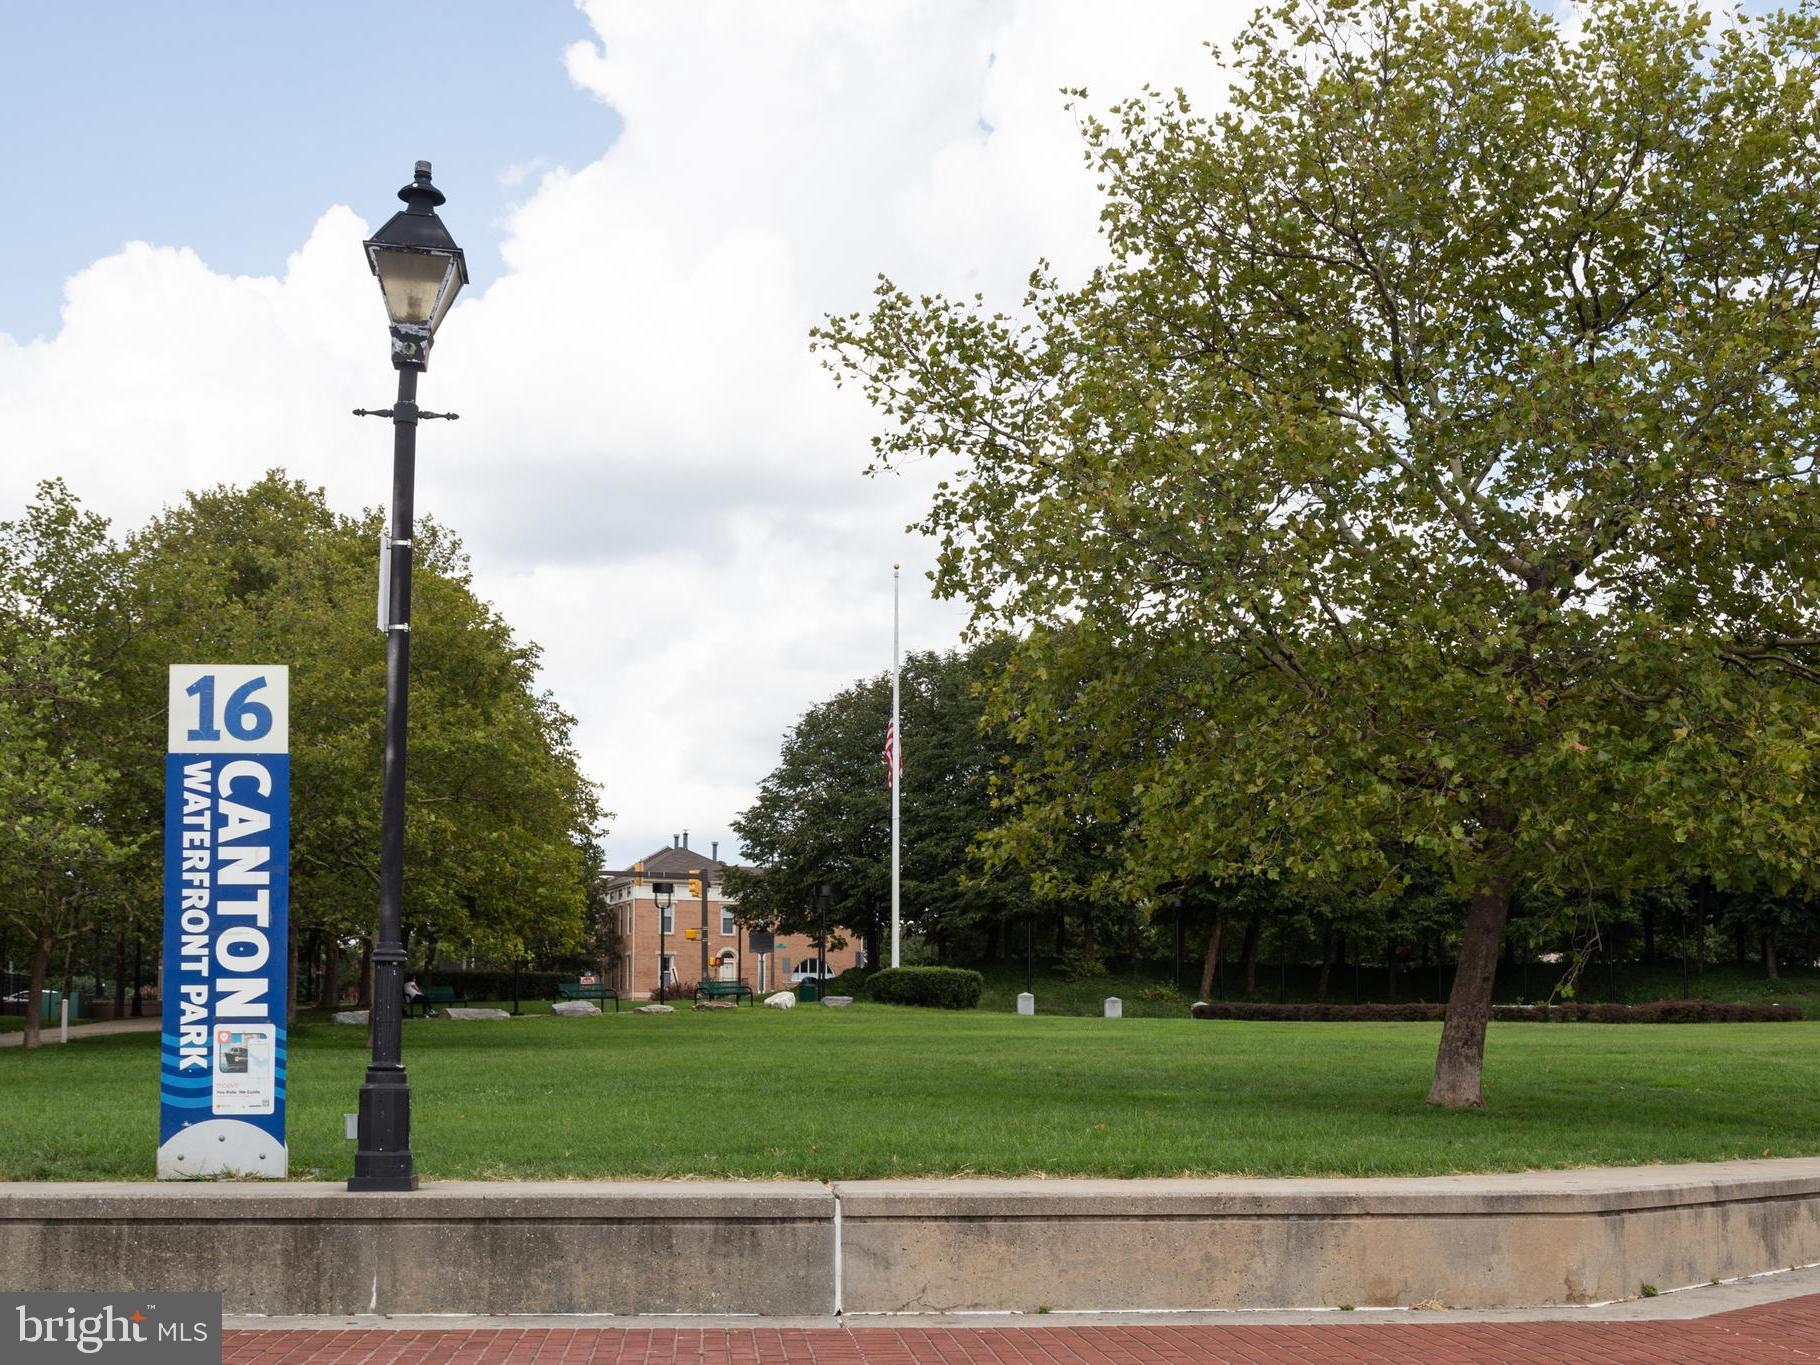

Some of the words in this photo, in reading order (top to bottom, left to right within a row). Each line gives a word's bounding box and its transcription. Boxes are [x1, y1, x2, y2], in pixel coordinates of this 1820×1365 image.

[186, 675, 273, 741] 16
[180, 760, 212, 977] WATERFRONT
[215, 760, 272, 1017] CANTON
[180, 984, 208, 1071] PARK
